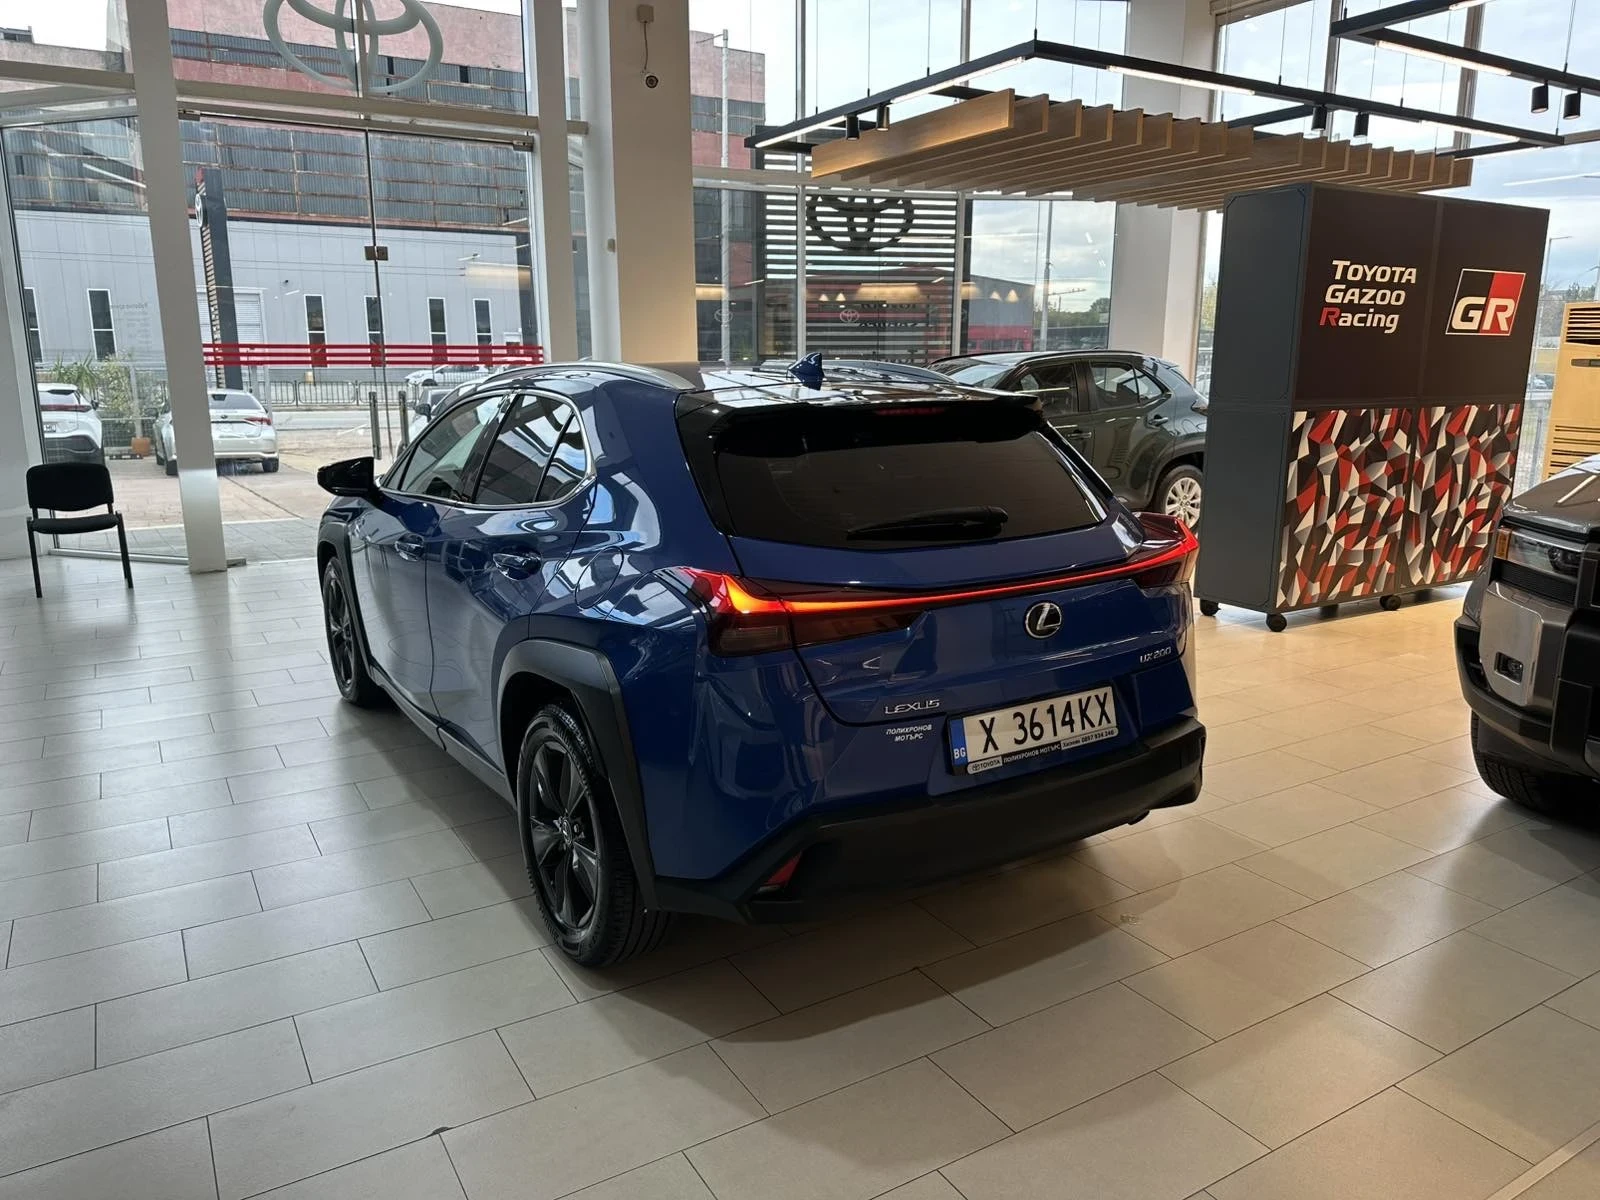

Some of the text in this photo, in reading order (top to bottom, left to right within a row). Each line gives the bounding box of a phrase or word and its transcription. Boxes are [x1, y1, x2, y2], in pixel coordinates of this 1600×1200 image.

[1332, 260, 1417, 284] TOYOTA
[1325, 284, 1406, 306] GAZOO
[1319, 306, 1400, 334] Racing
[1451, 296, 1515, 331] GR
[1140, 646, 1172, 664] UX 200
[885, 699, 940, 714] LEXUS
[886, 724, 933, 735] ПОЛИХРОНОВ
[894, 732, 924, 742] МОТЪРС
[979, 716, 1000, 754] X
[953, 748, 967, 760] BG
[1003, 750, 1039, 764] ПОЛИХРОНОВ
[980, 759, 1000, 769] TOYOTA
